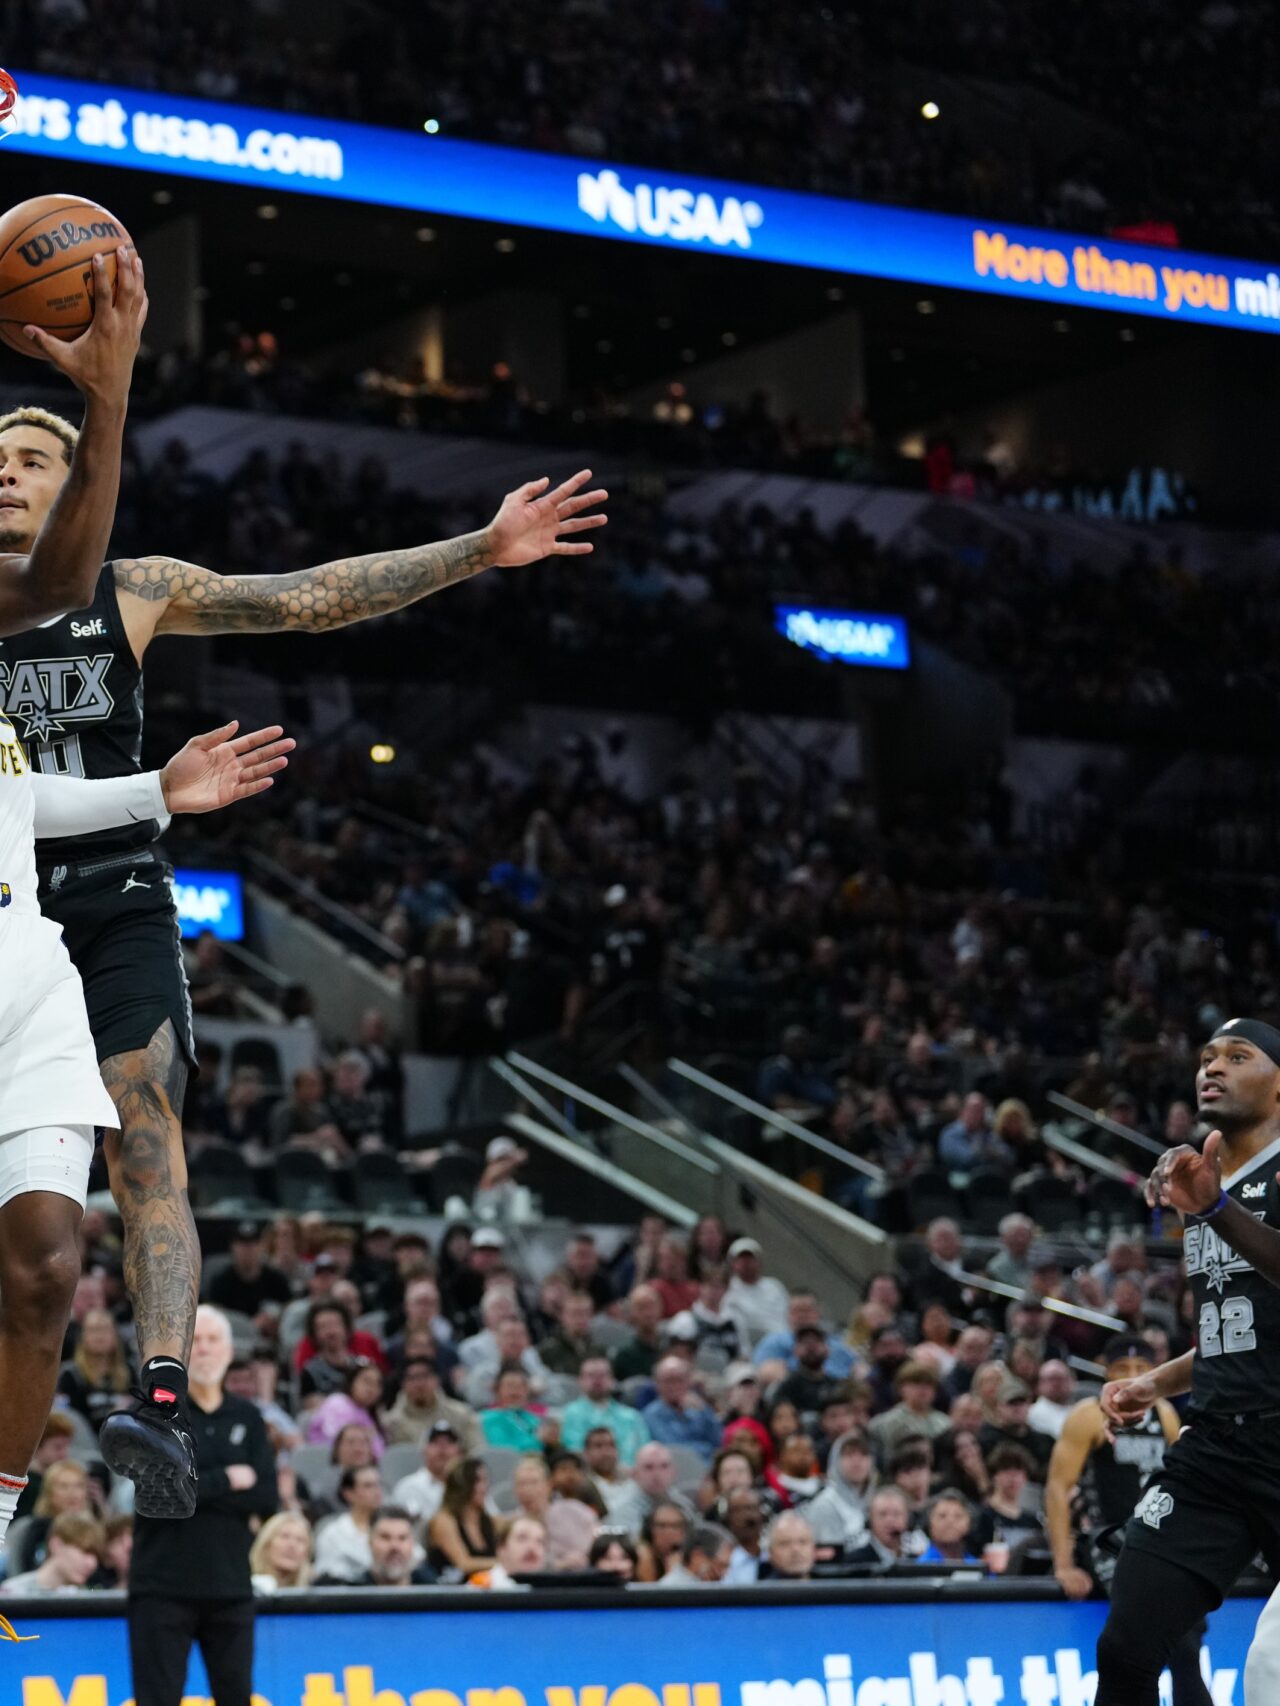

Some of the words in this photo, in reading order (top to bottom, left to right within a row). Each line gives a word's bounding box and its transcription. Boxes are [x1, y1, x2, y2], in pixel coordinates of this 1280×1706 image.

[76, 98, 127, 149] at
[132, 111, 344, 181] usaa.com
[17, 222, 121, 267] Wilson
[972, 229, 1069, 288] More
[1072, 246, 1158, 301] than
[1161, 266, 1230, 312] you
[1199, 1296, 1257, 1358] 22
